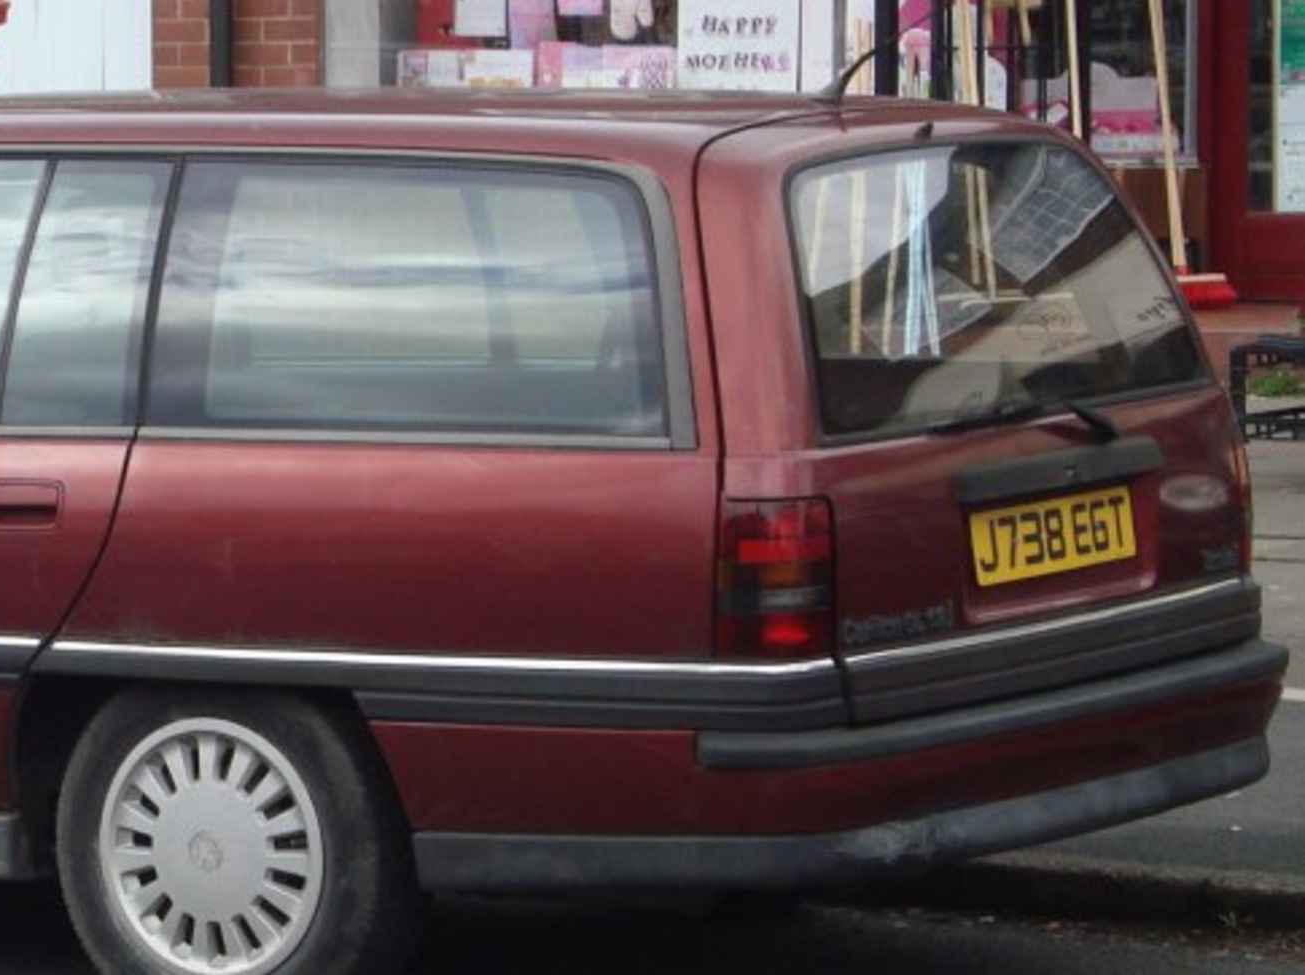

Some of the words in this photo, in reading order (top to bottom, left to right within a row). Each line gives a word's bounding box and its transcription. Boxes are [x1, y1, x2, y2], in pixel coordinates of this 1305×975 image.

[702, 14, 777, 35] HAPPY
[687, 52, 789, 73] MOTHERS
[980, 509, 1066, 572] J738
